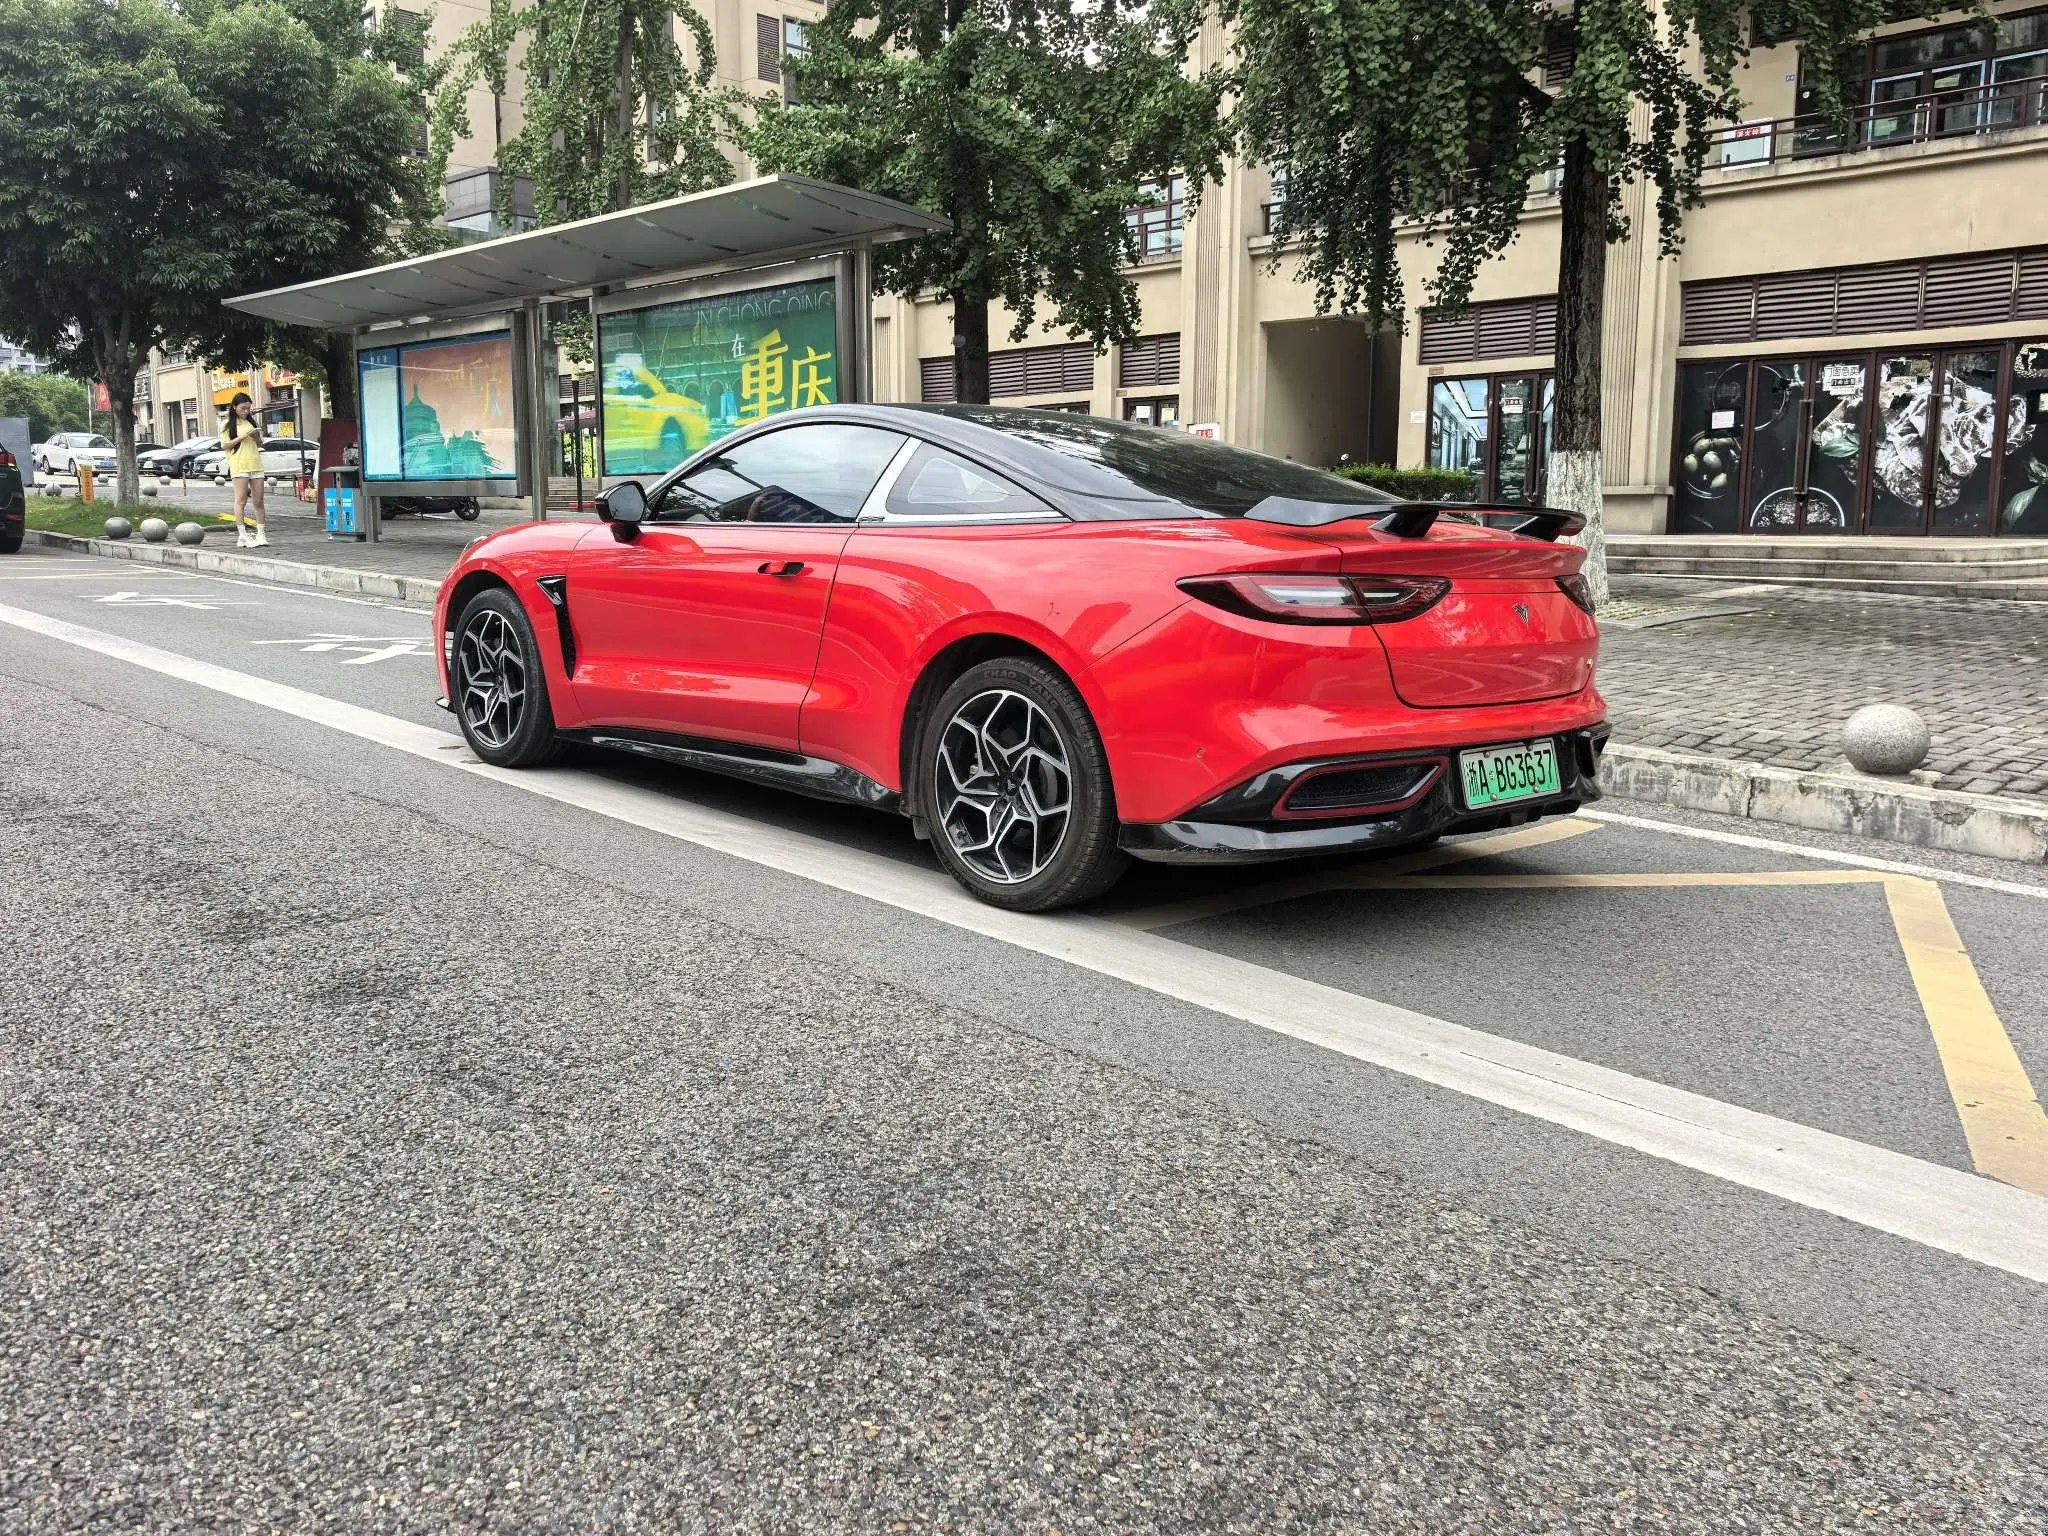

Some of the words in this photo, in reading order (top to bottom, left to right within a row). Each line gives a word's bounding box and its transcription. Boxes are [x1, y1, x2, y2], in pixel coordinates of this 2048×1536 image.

[730, 333, 746, 358] 在
[735, 328, 832, 427] 重庆
[983, 669, 1017, 681] CHAO
